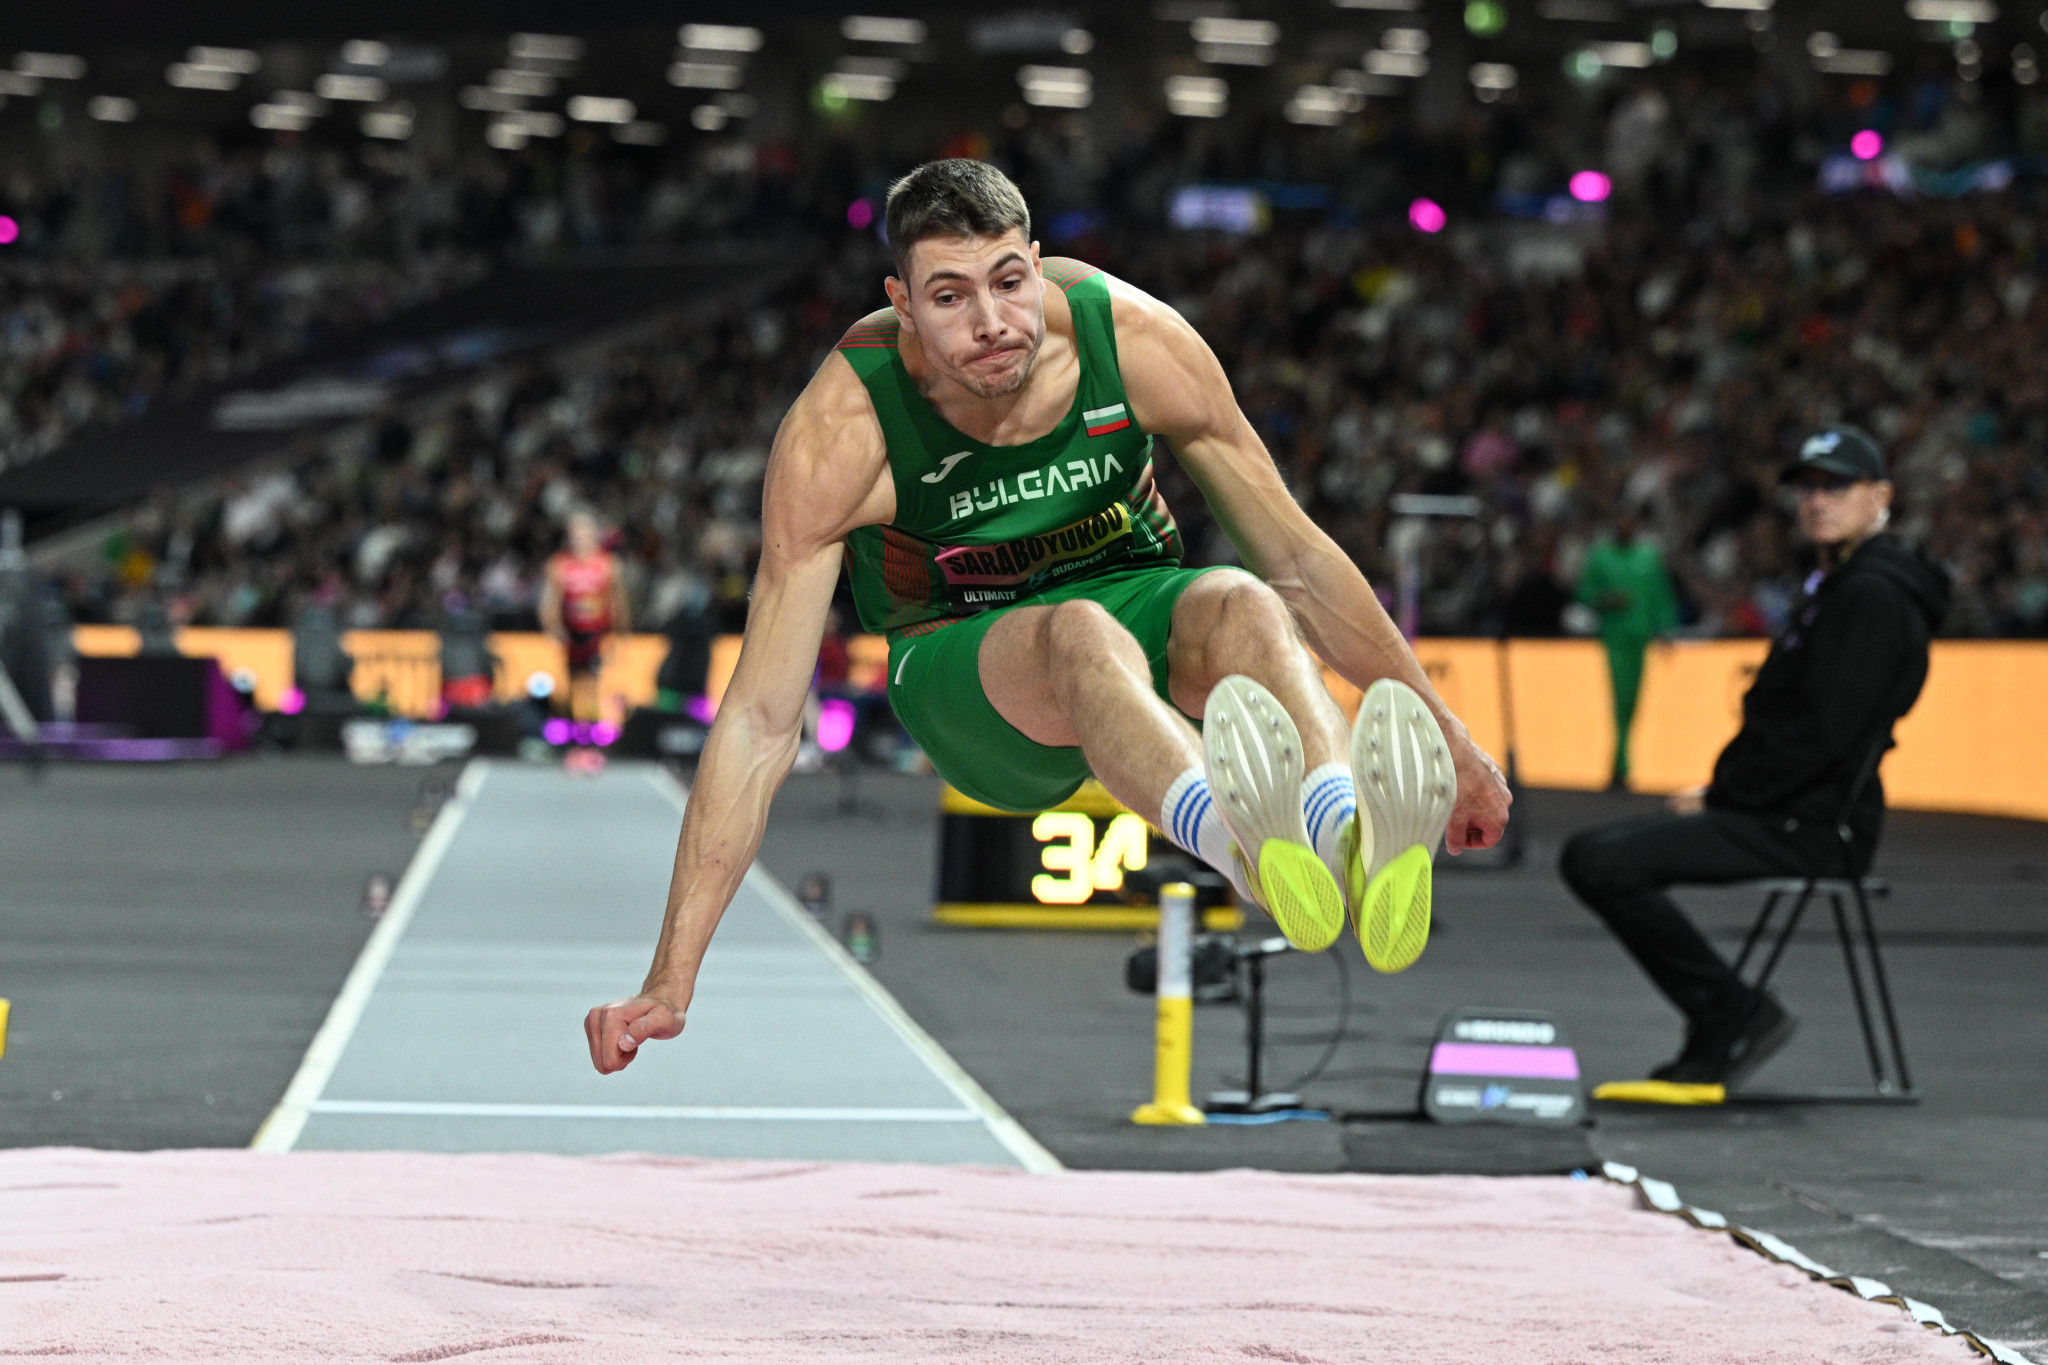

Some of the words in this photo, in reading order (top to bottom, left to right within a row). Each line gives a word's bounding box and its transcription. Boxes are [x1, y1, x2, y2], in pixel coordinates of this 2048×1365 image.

[950, 453, 1124, 520] BULGARIA
[945, 504, 1123, 576] SARABOYUKOV
[1052, 549, 1108, 577] BUDAPEST
[963, 590, 1017, 603] ULTIMATE
